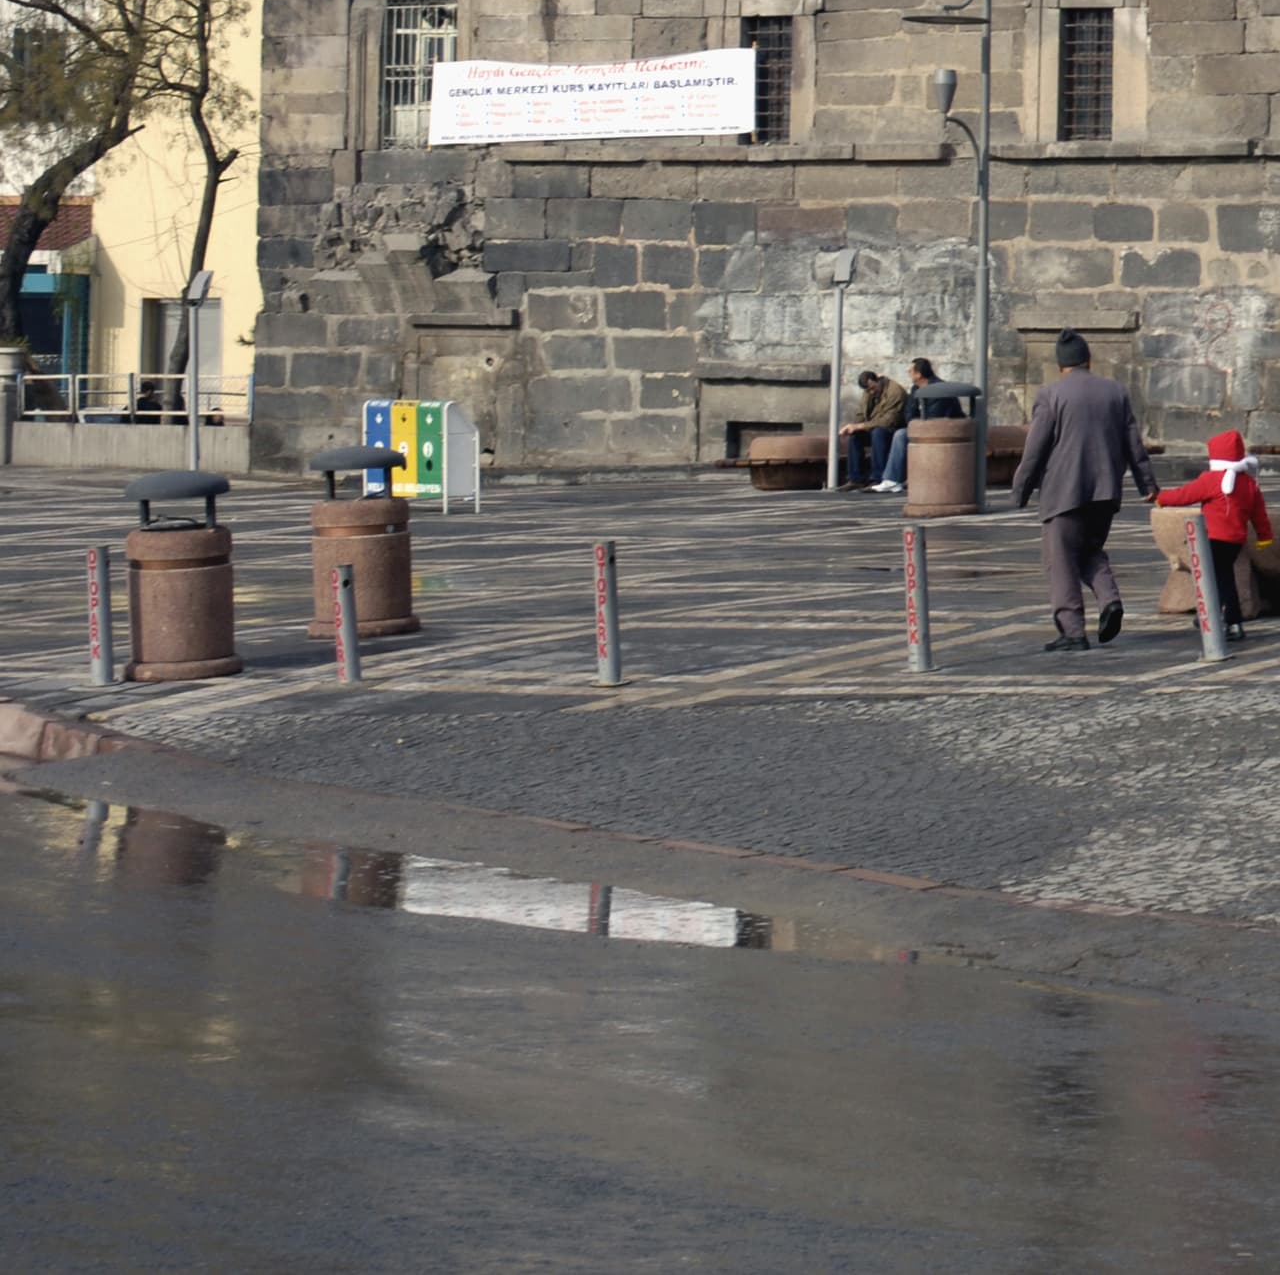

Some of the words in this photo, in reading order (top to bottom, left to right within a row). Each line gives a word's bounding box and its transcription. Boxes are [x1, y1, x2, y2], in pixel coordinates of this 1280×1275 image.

[448, 86, 493, 98] GENÇLİK
[497, 84, 549, 95] MERKEZİ
[552, 82, 585, 94] KURS
[588, 81, 650, 92] KAYITLARI
[653, 76, 739, 90] BAŞLAMIŞTIR.
[86, 549, 101, 660] OTOPARK
[593, 545, 608, 659] OTOPARK
[902, 530, 920, 645] OTOPARK
[1184, 520, 1212, 633] OTOPARK
